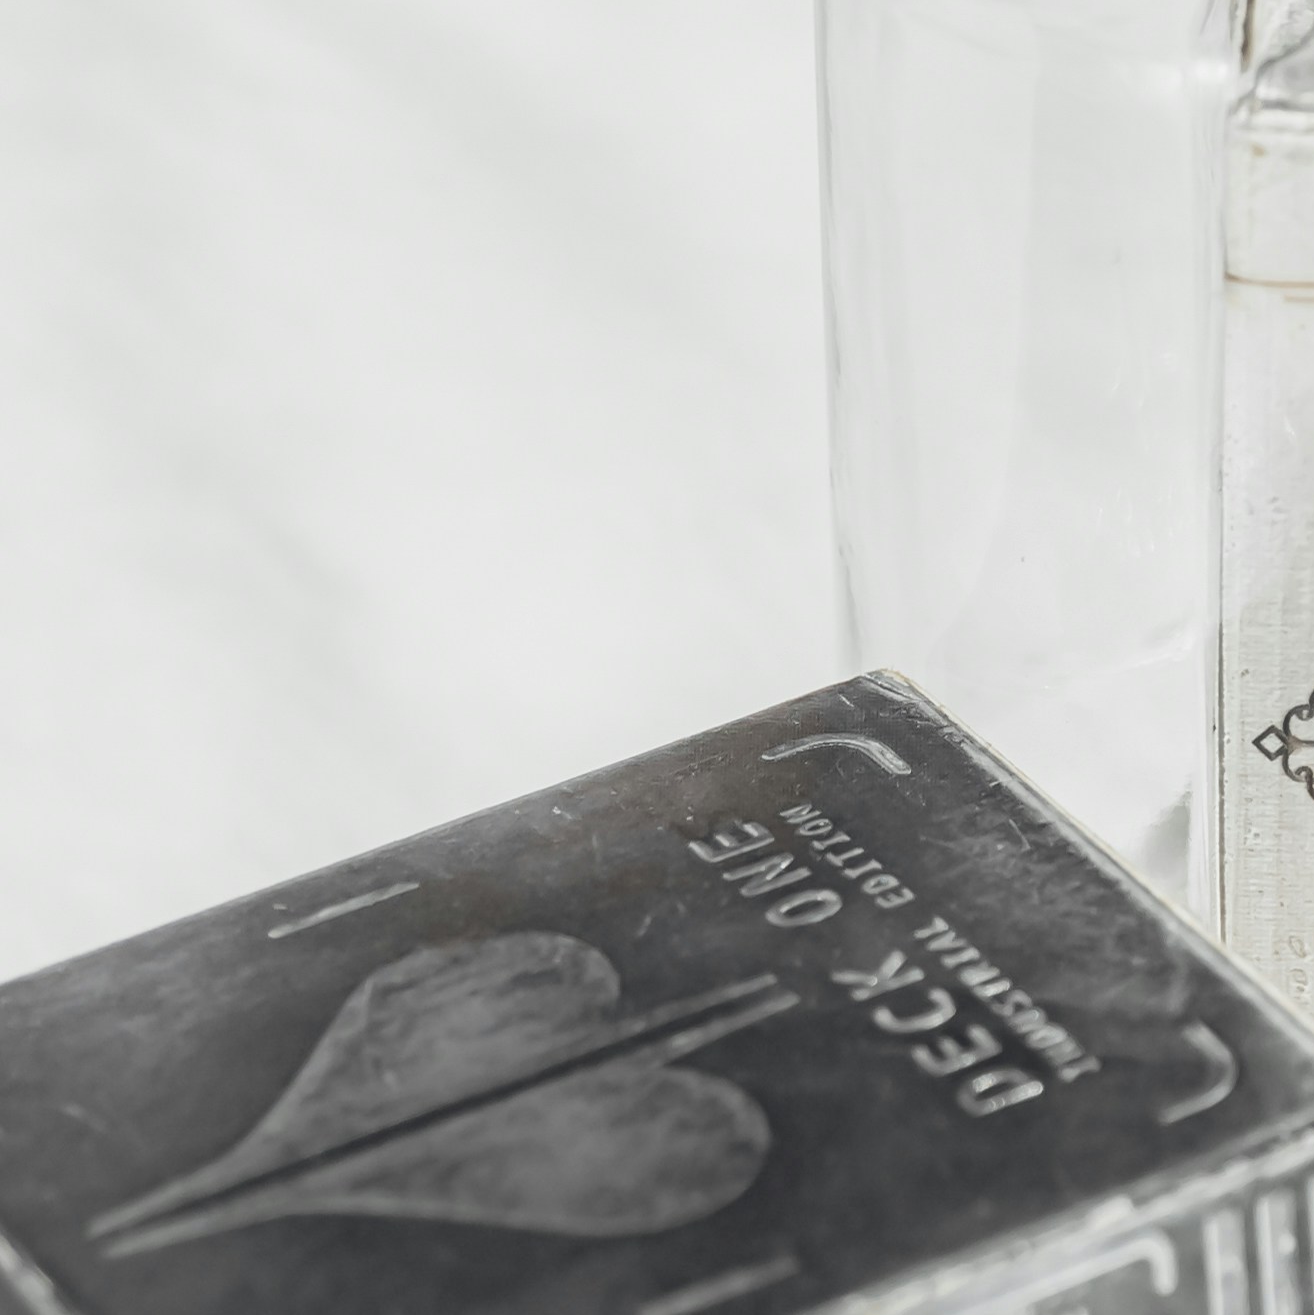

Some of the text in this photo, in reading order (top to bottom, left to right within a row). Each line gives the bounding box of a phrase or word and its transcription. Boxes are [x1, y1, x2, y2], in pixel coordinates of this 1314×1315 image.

[688, 819, 1043, 1117] DECK ONE
[780, 802, 1101, 1082] INDUSTRIAL EDITION
